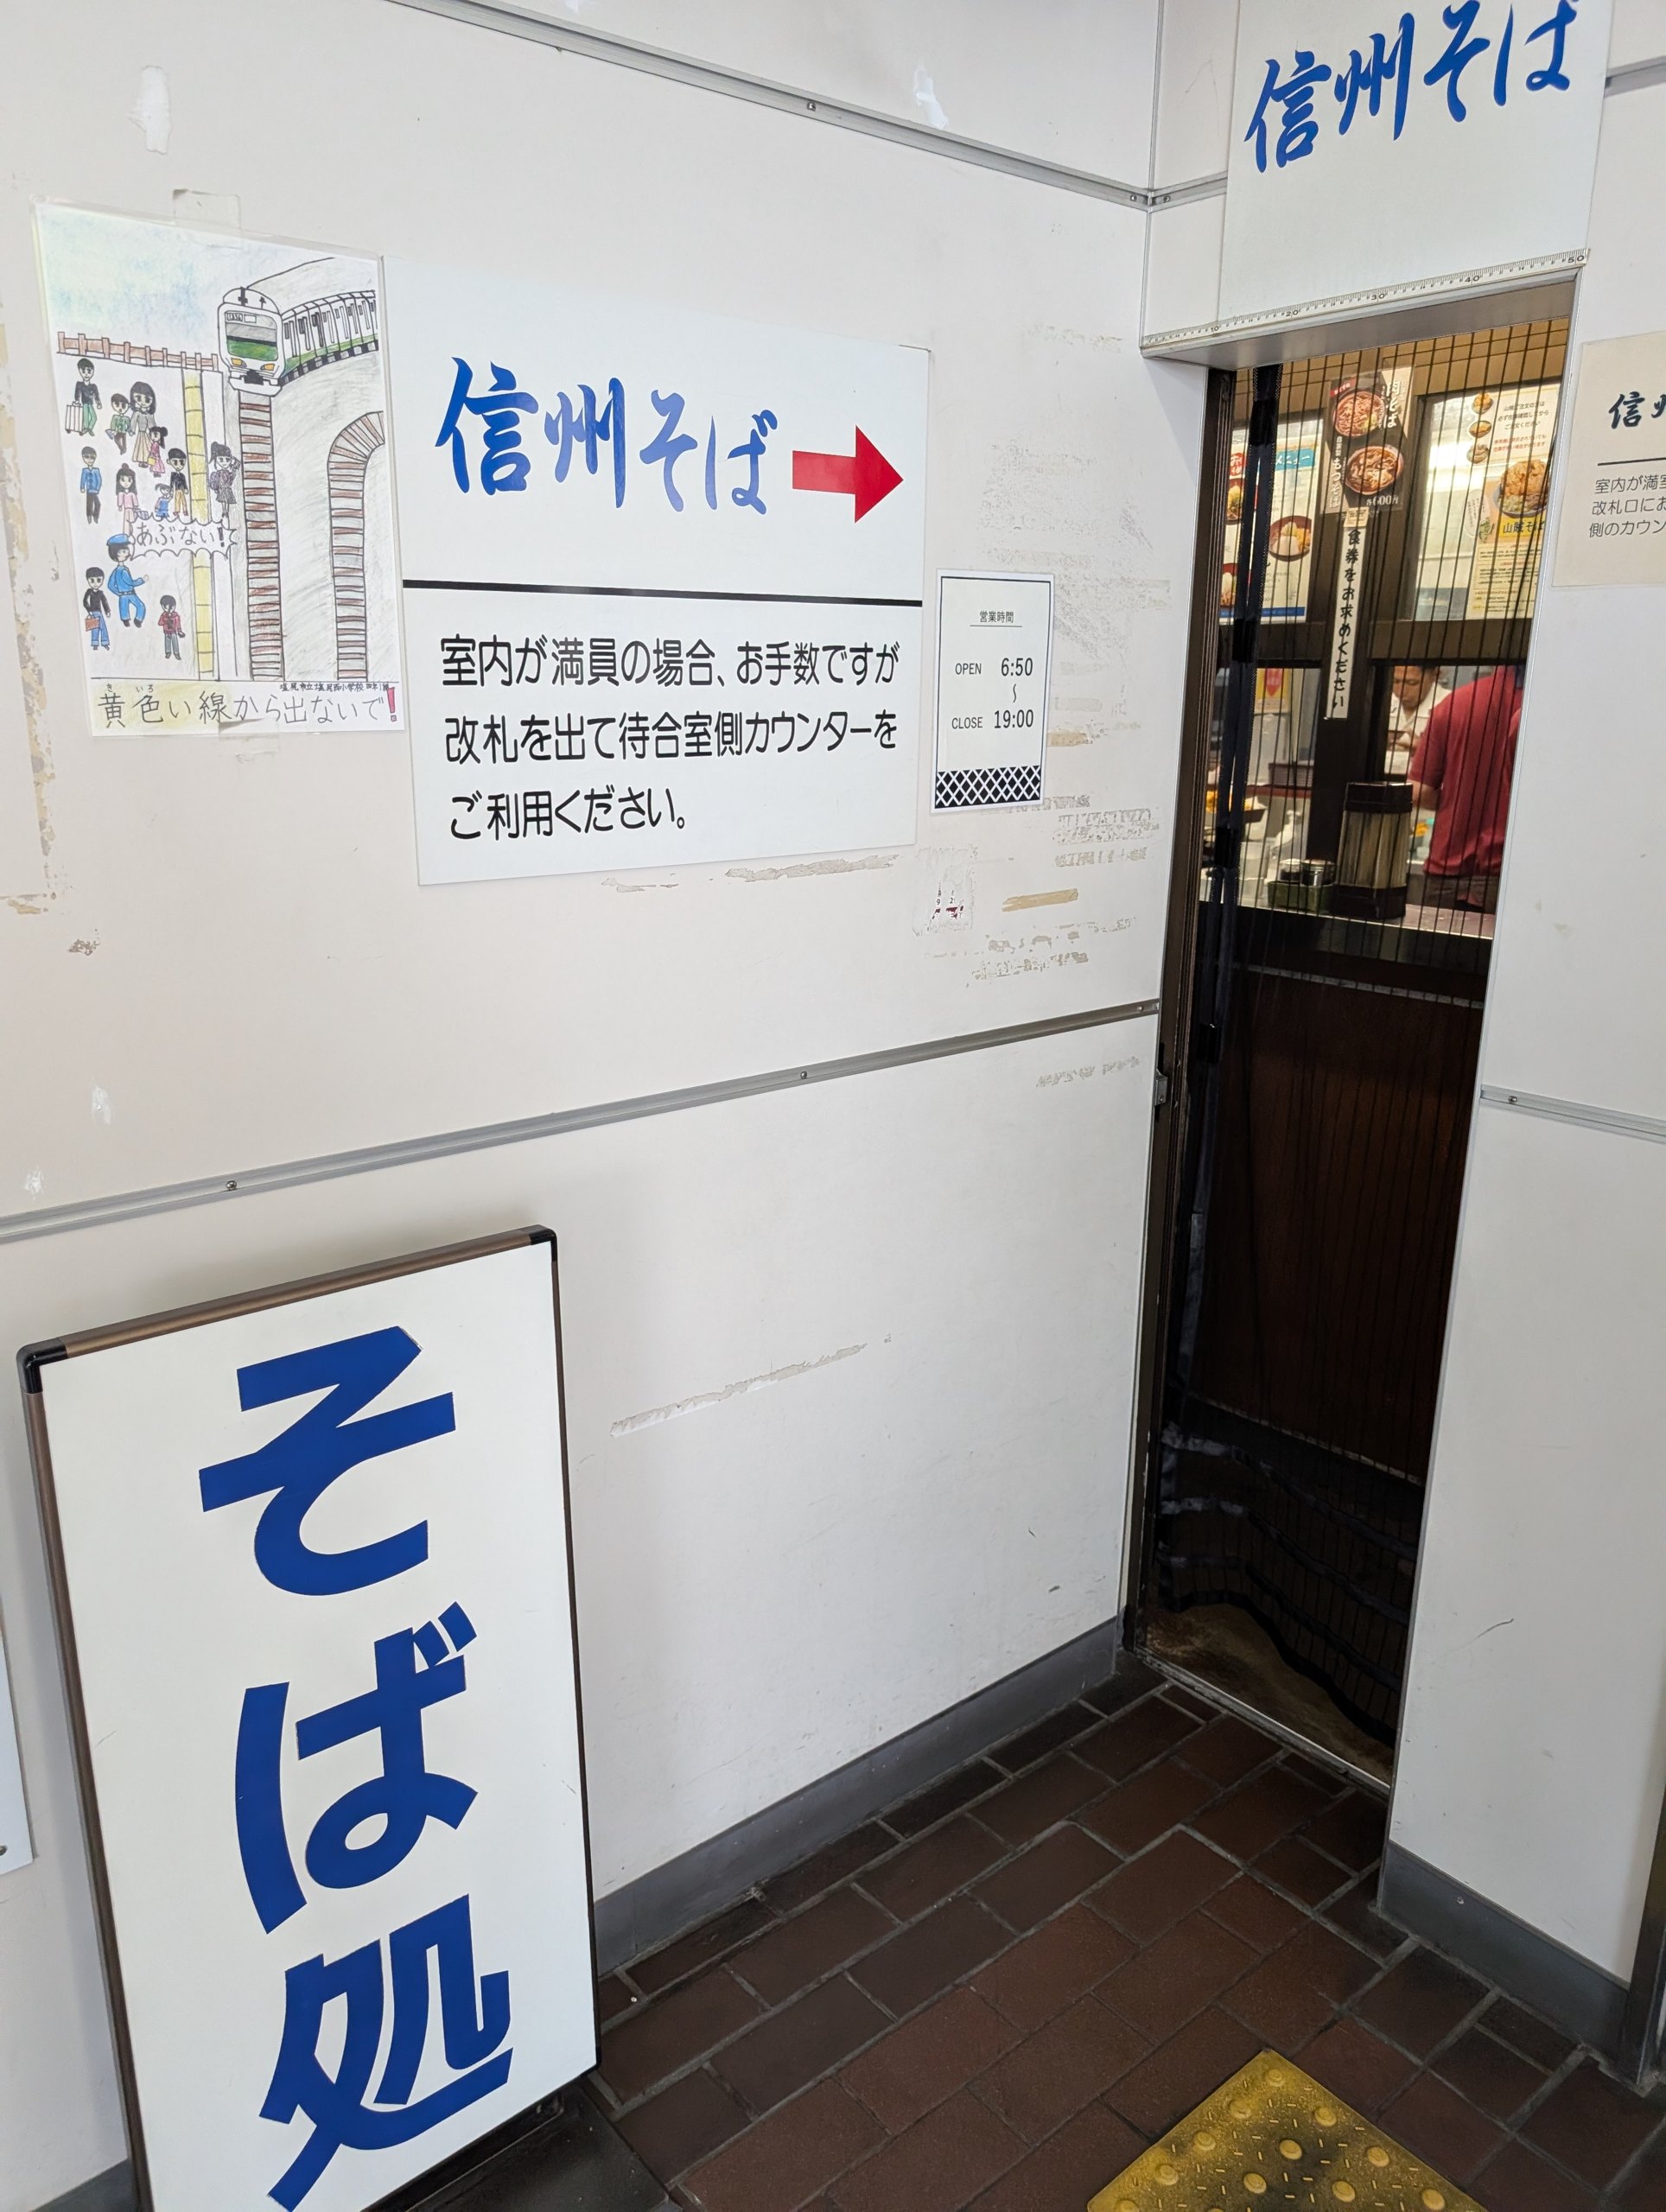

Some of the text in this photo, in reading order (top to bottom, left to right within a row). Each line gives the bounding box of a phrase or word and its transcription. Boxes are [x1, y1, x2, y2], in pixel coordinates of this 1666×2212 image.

[1567, 255, 1585, 264] 50
[1371, 292, 1385, 301] 30
[435, 356, 778, 515] 信州そば
[137, 521, 225, 548] あぶない!
[1589, 518, 1666, 538] 側のカウン
[979, 610, 1014, 623] 営業時間
[1333, 529, 1361, 709] 食券をお求めください
[440, 633, 900, 688] 室内が満員の場合、お手数ですが
[955, 658, 1033, 677] OPEN 6:50
[98, 687, 397, 728] 黄色い線から出ないで!
[951, 709, 1034, 729] CLOSE 19:00
[444, 709, 898, 765] 改札を出て待合室側カウンターを
[450, 784, 686, 841] ご利用ください。
[199, 1326, 514, 2212] そば処
